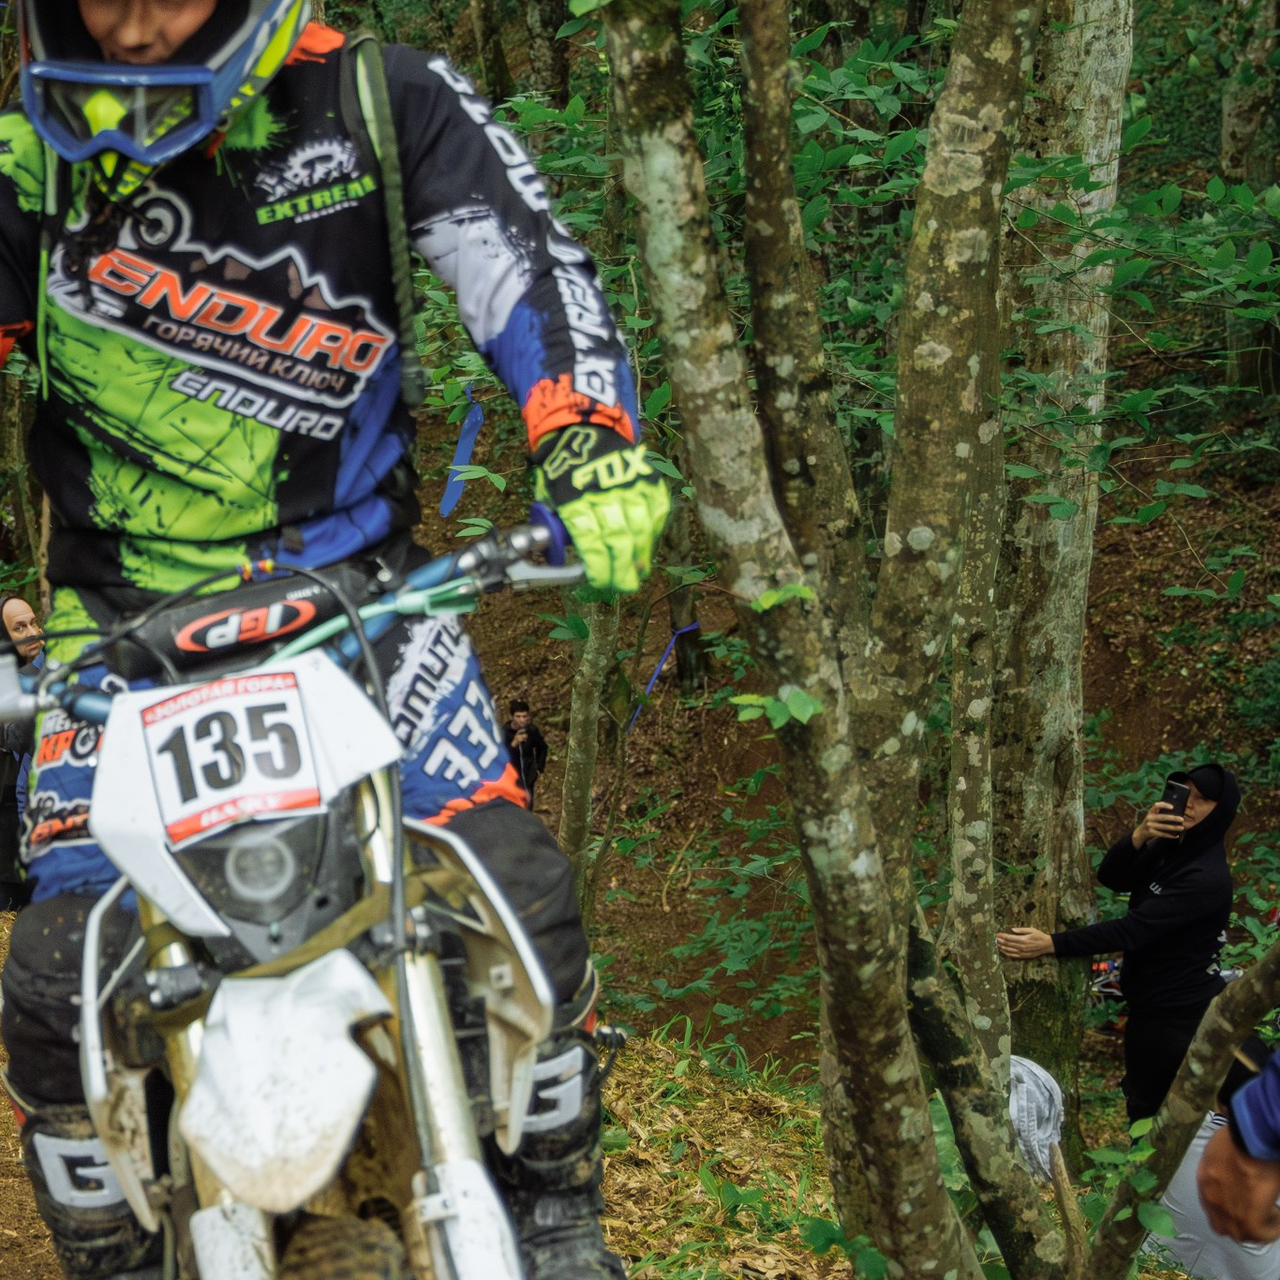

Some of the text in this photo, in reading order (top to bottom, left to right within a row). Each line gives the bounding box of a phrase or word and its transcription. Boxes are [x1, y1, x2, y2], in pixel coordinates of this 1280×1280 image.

[87, 248, 389, 371] ENDURO
[142, 314, 347, 393] ГОРЯЧИЙ КЛЮЧ
[170, 371, 345, 441] ENDURO
[572, 443, 653, 491] FOX
[157, 702, 302, 804] 135
